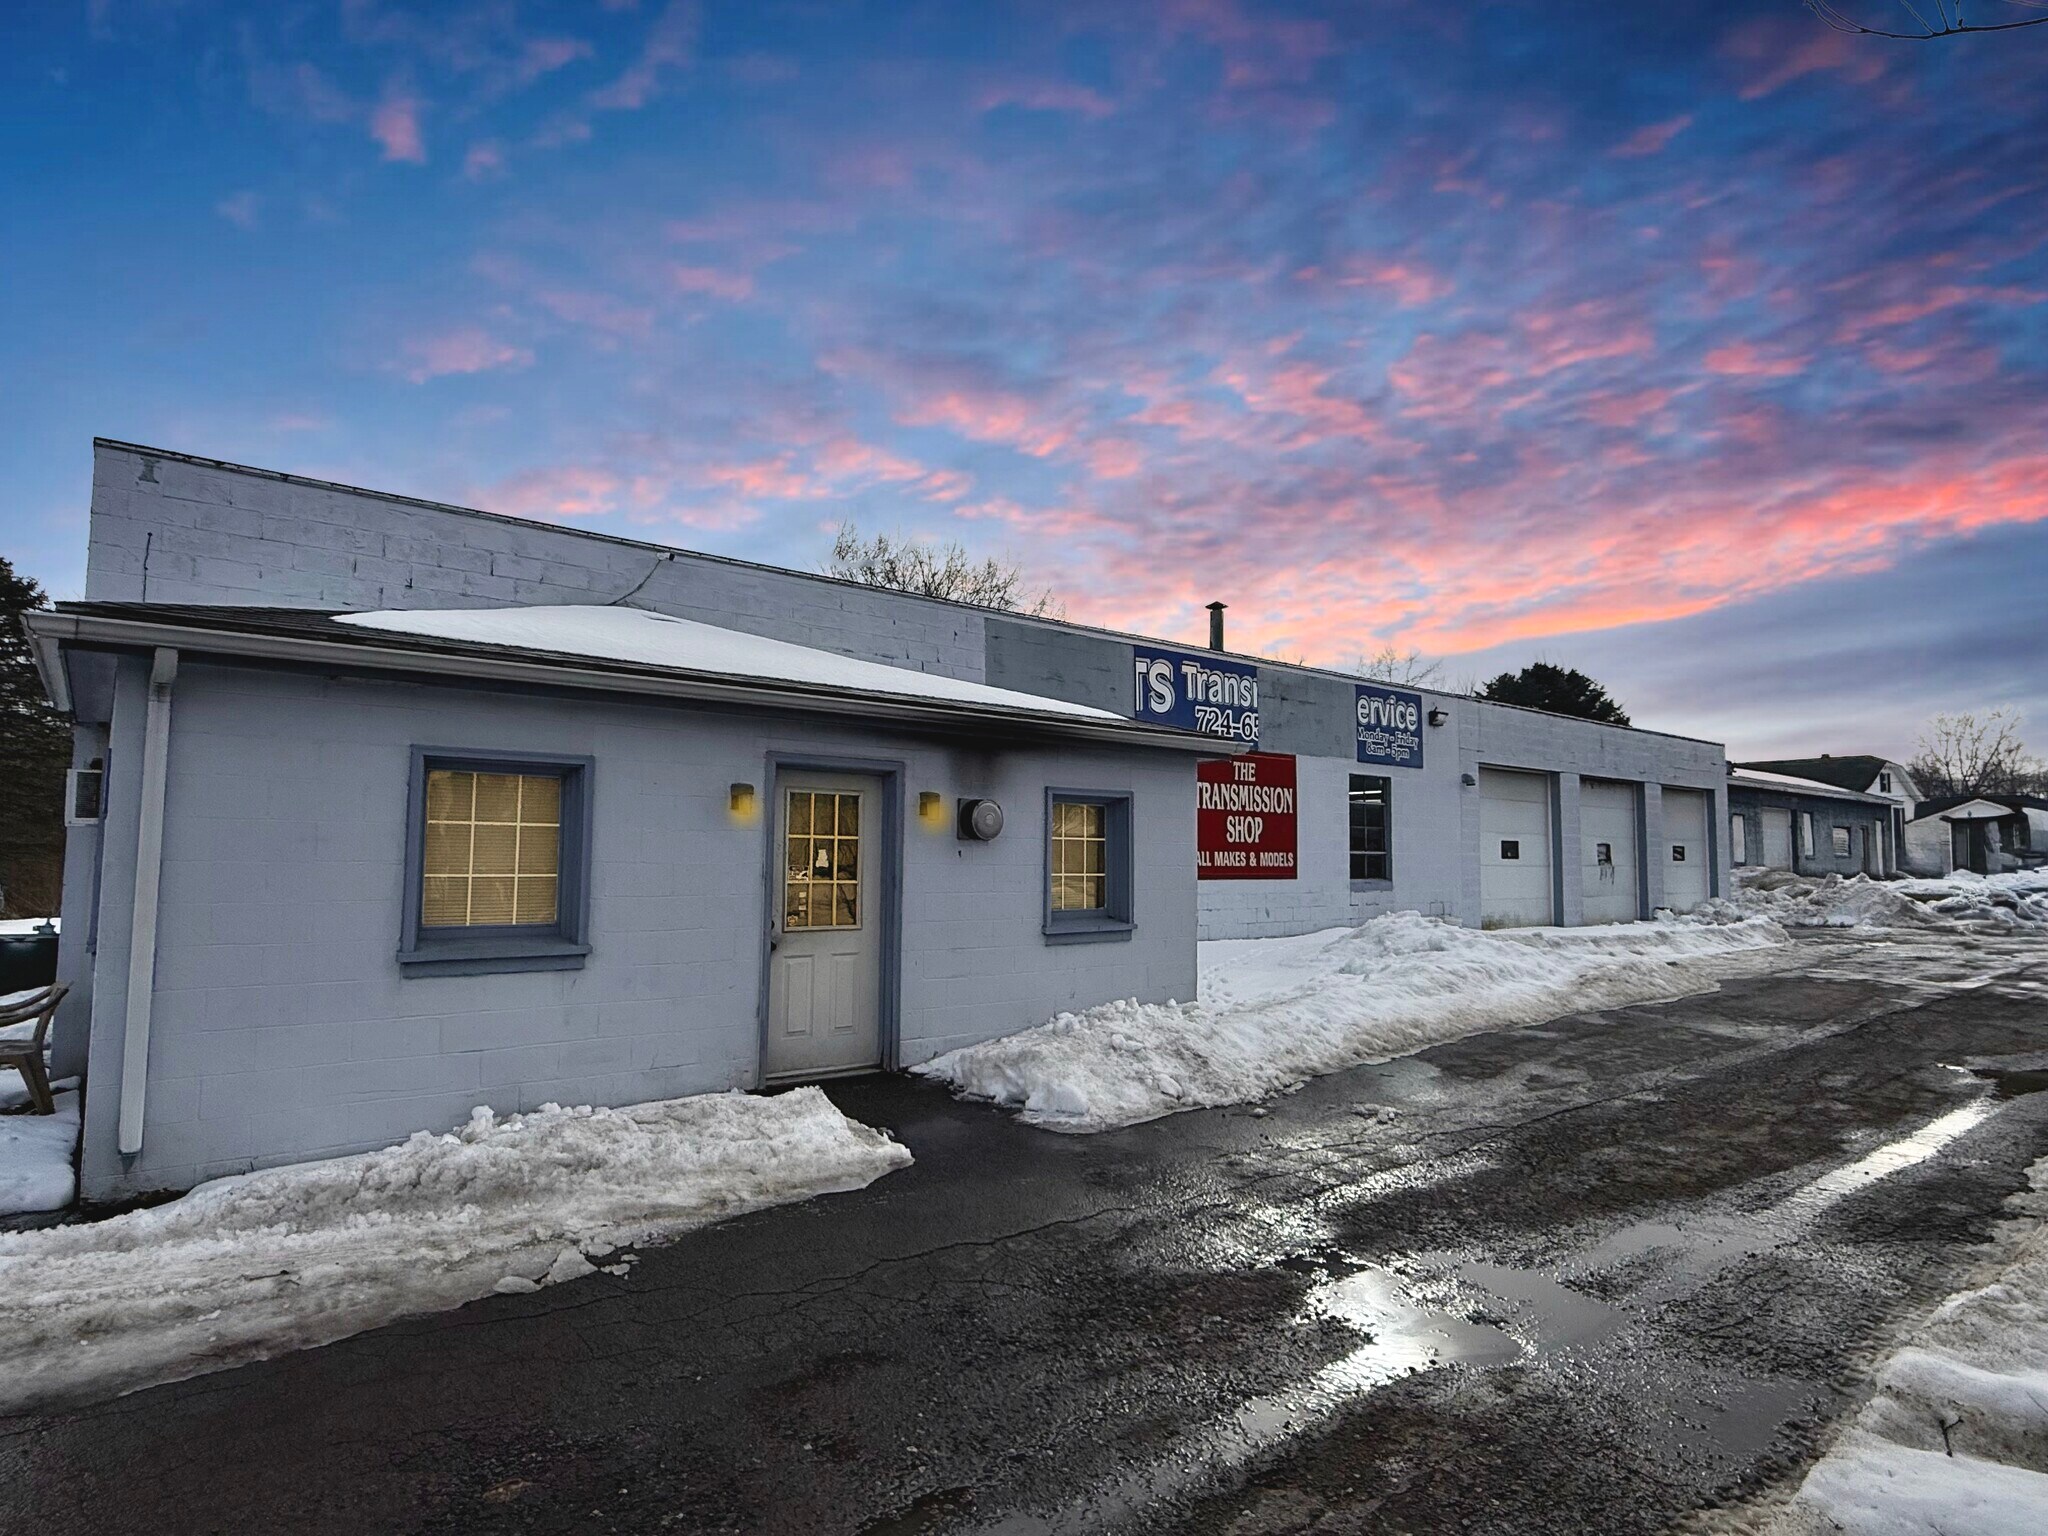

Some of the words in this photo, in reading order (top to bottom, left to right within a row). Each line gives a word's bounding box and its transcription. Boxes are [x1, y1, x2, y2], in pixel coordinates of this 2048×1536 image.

[1357, 694, 1418, 732] ervice
[1233, 761, 1256, 781] THE
[1196, 781, 1294, 814] TRANSMISSION
[1226, 815, 1263, 844] SHOP
[1214, 851, 1247, 867] MAKES
[1249, 851, 1257, 867] &
[1259, 851, 1294, 867] MODELS
